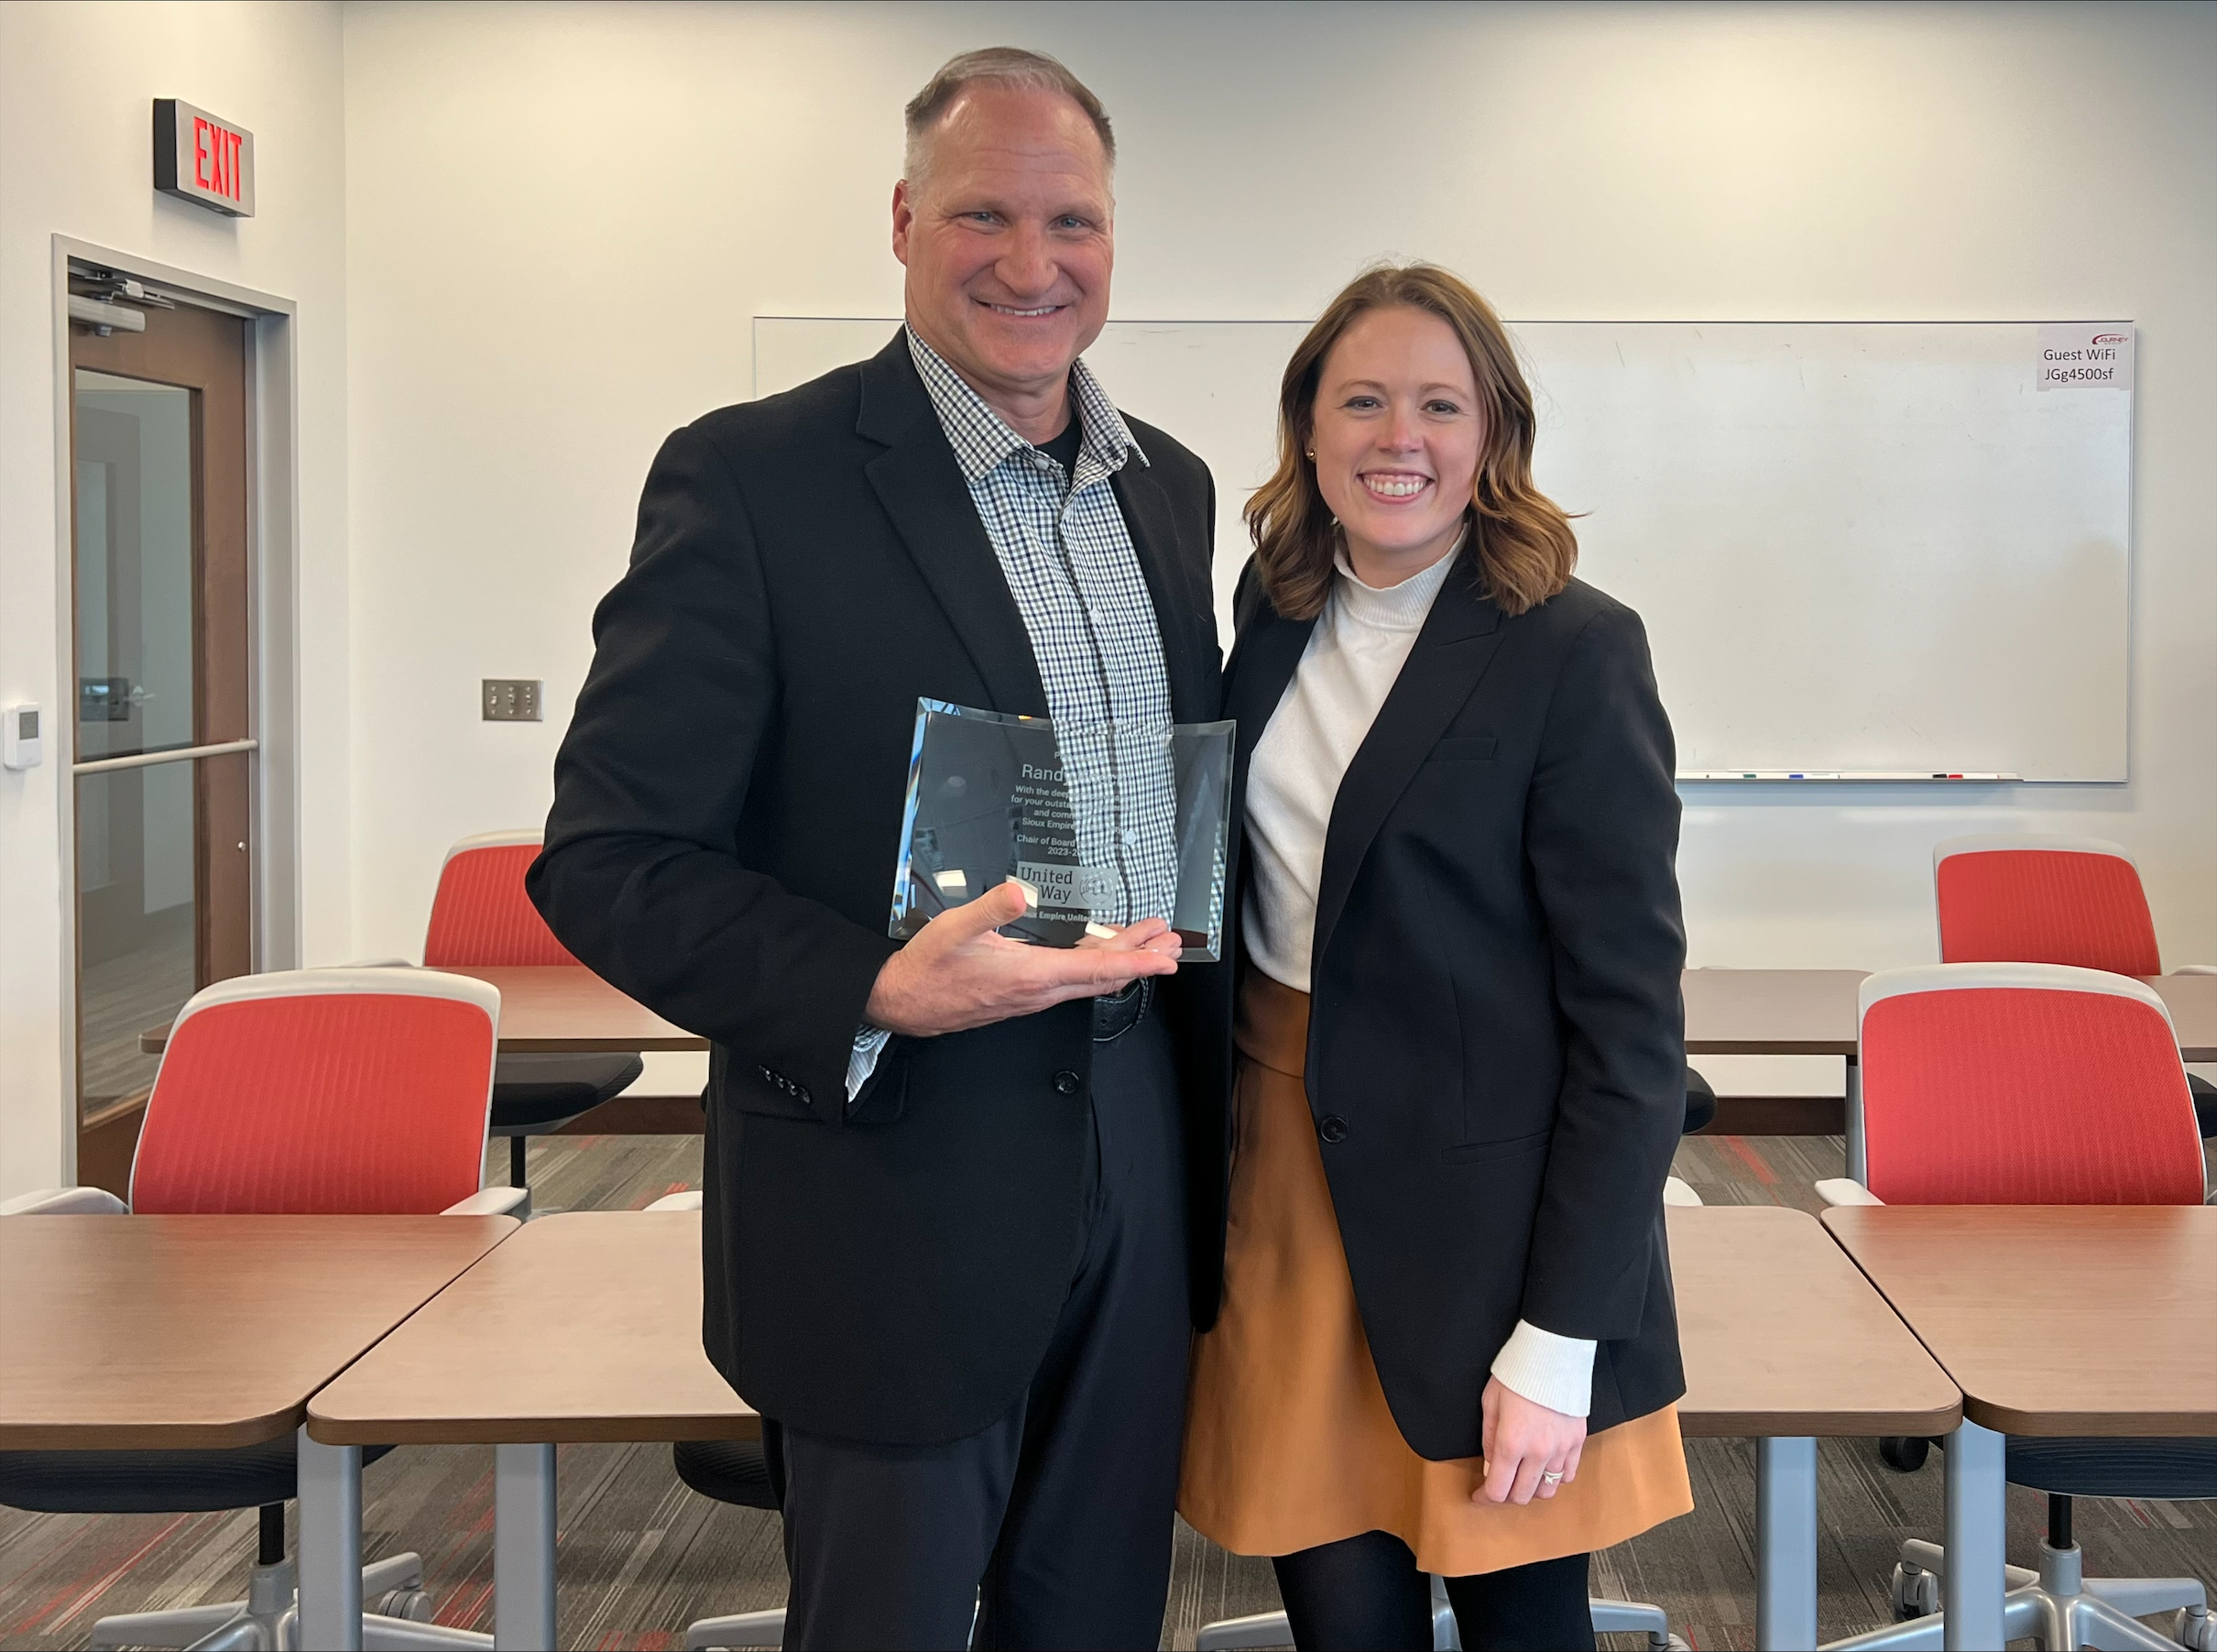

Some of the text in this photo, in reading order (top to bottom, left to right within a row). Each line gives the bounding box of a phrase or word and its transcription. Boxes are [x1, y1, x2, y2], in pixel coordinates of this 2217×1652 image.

[193, 115, 242, 202] EXIT
[2044, 348, 2115, 360] Guest WiFi
[2045, 367, 2114, 383] JGg4500sf
[1015, 784, 1034, 794] With
[1036, 787, 1050, 796] the
[1010, 794, 1022, 804] for
[1024, 798, 1043, 806] your
[1033, 809, 1050, 817] and
[1021, 817, 1045, 826] Sioux
[1047, 820, 1077, 830] Empire
[1016, 834, 1039, 844] Chair
[1040, 837, 1050, 845] of
[1051, 837, 1076, 848] Board
[1021, 867, 1073, 884] United
[1040, 884, 1072, 904] Way
[1039, 911, 1067, 922] Empire
